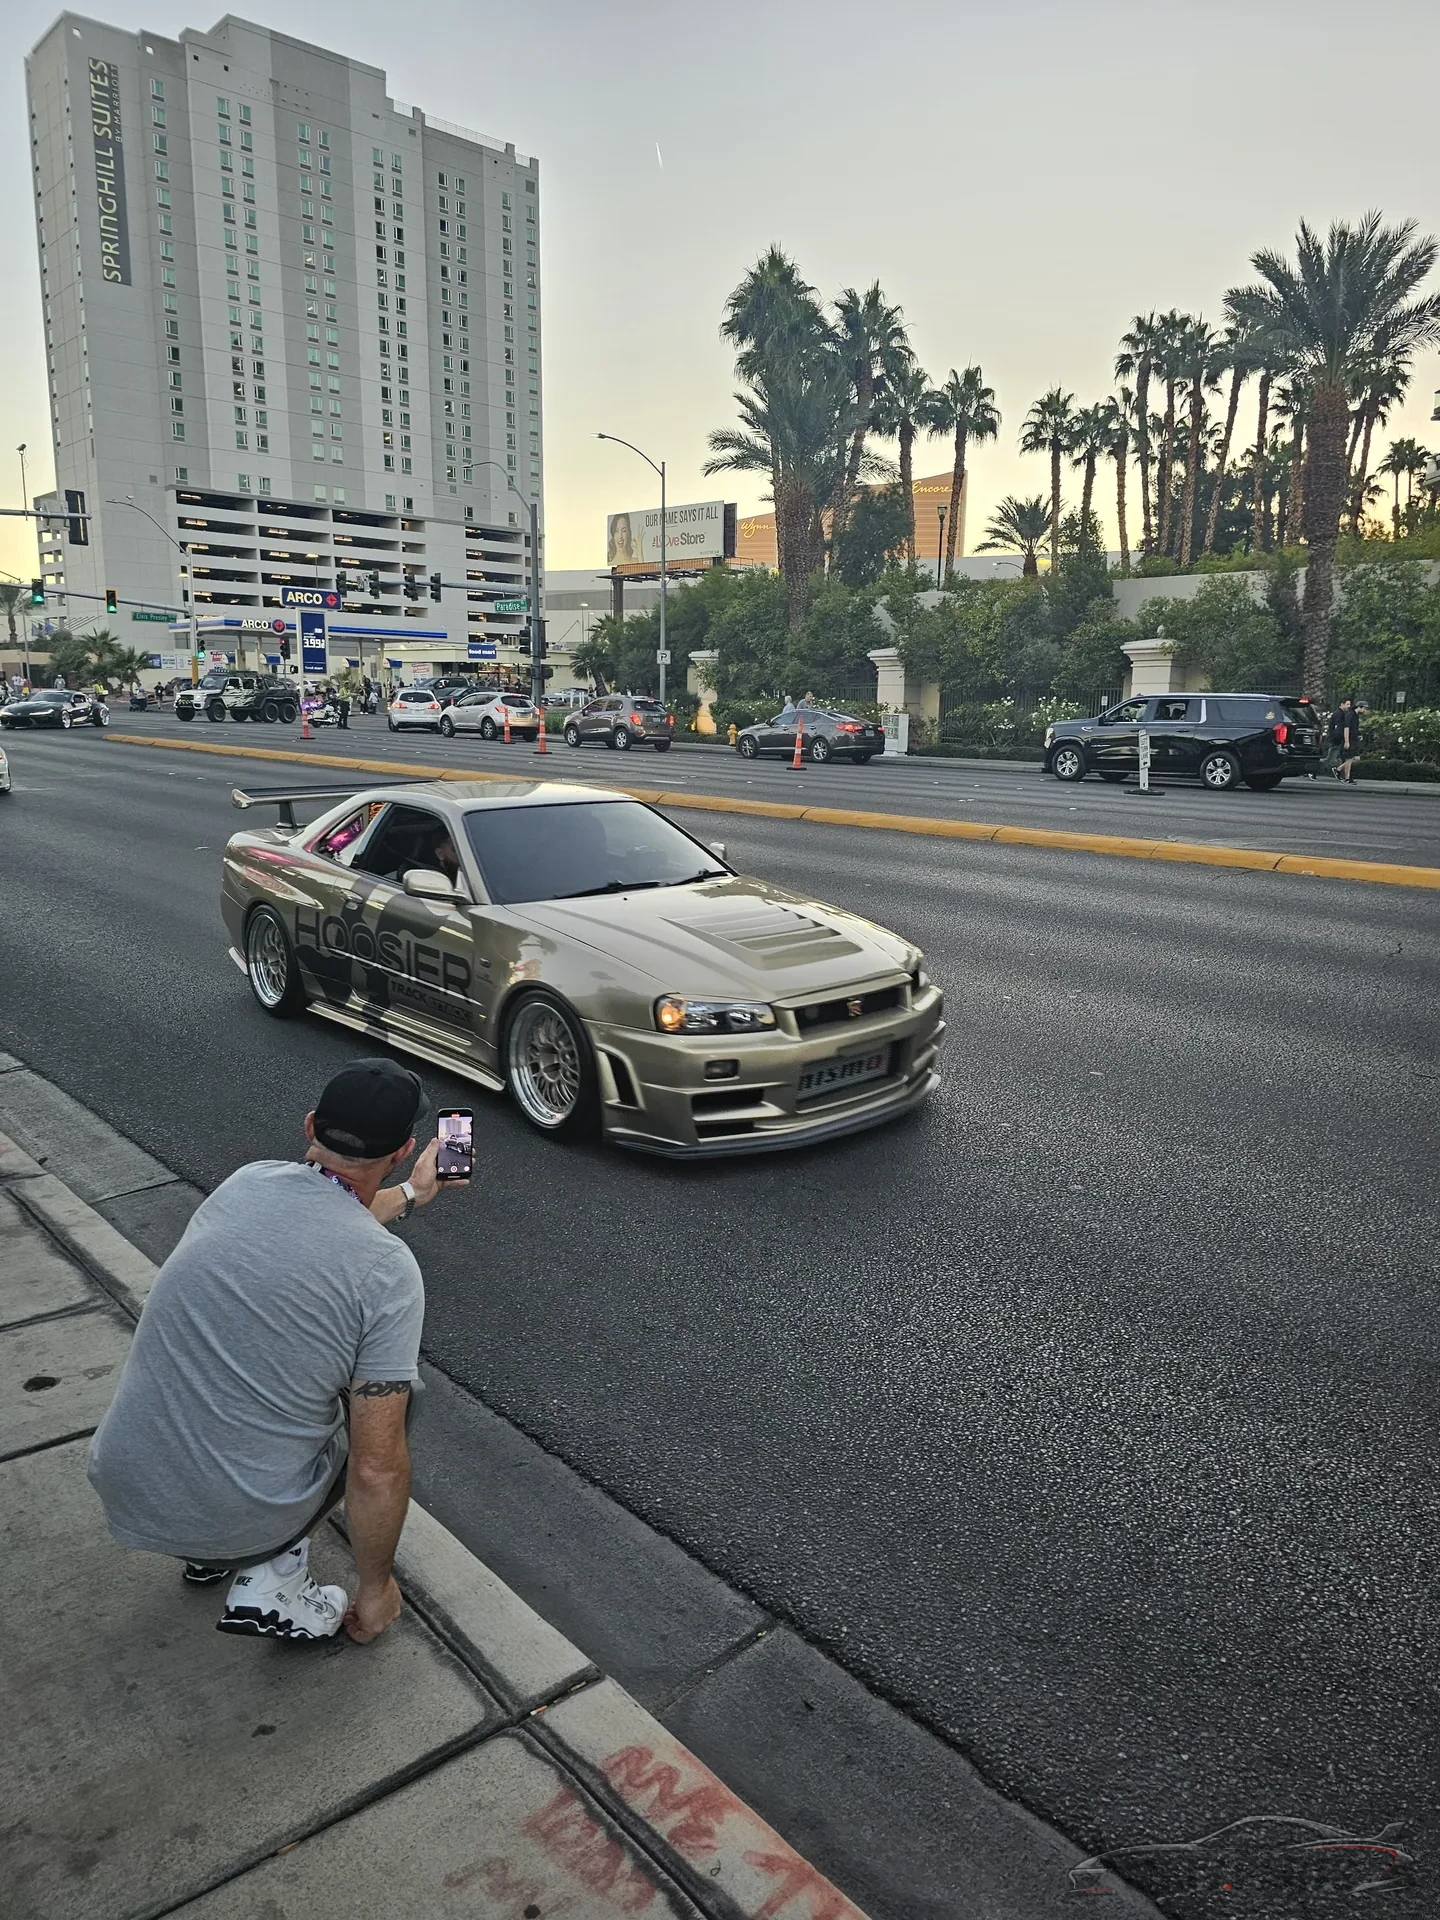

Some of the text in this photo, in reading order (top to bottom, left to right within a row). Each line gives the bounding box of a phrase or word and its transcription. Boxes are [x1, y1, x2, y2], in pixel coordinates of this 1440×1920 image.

[111, 64, 122, 142] BY MARRIOTT
[89, 59, 122, 282] SPRINGHILL SUITES
[912, 481, 953, 494] Encore
[645, 513, 659, 527] OUR
[679, 509, 697, 523] SAYS
[697, 507, 706, 521] IT
[705, 506, 719, 520] ALL
[741, 518, 776, 538] Wynn
[680, 532, 705, 546] Store
[286, 591, 323, 605] ARCO
[496, 602, 520, 611] Paradise
[136, 612, 149, 620] Elvis
[150, 613, 168, 621] Presley
[241, 619, 269, 630] ARCO
[295, 906, 472, 1005] HOOSIER
[391, 981, 429, 1004] TRACK
